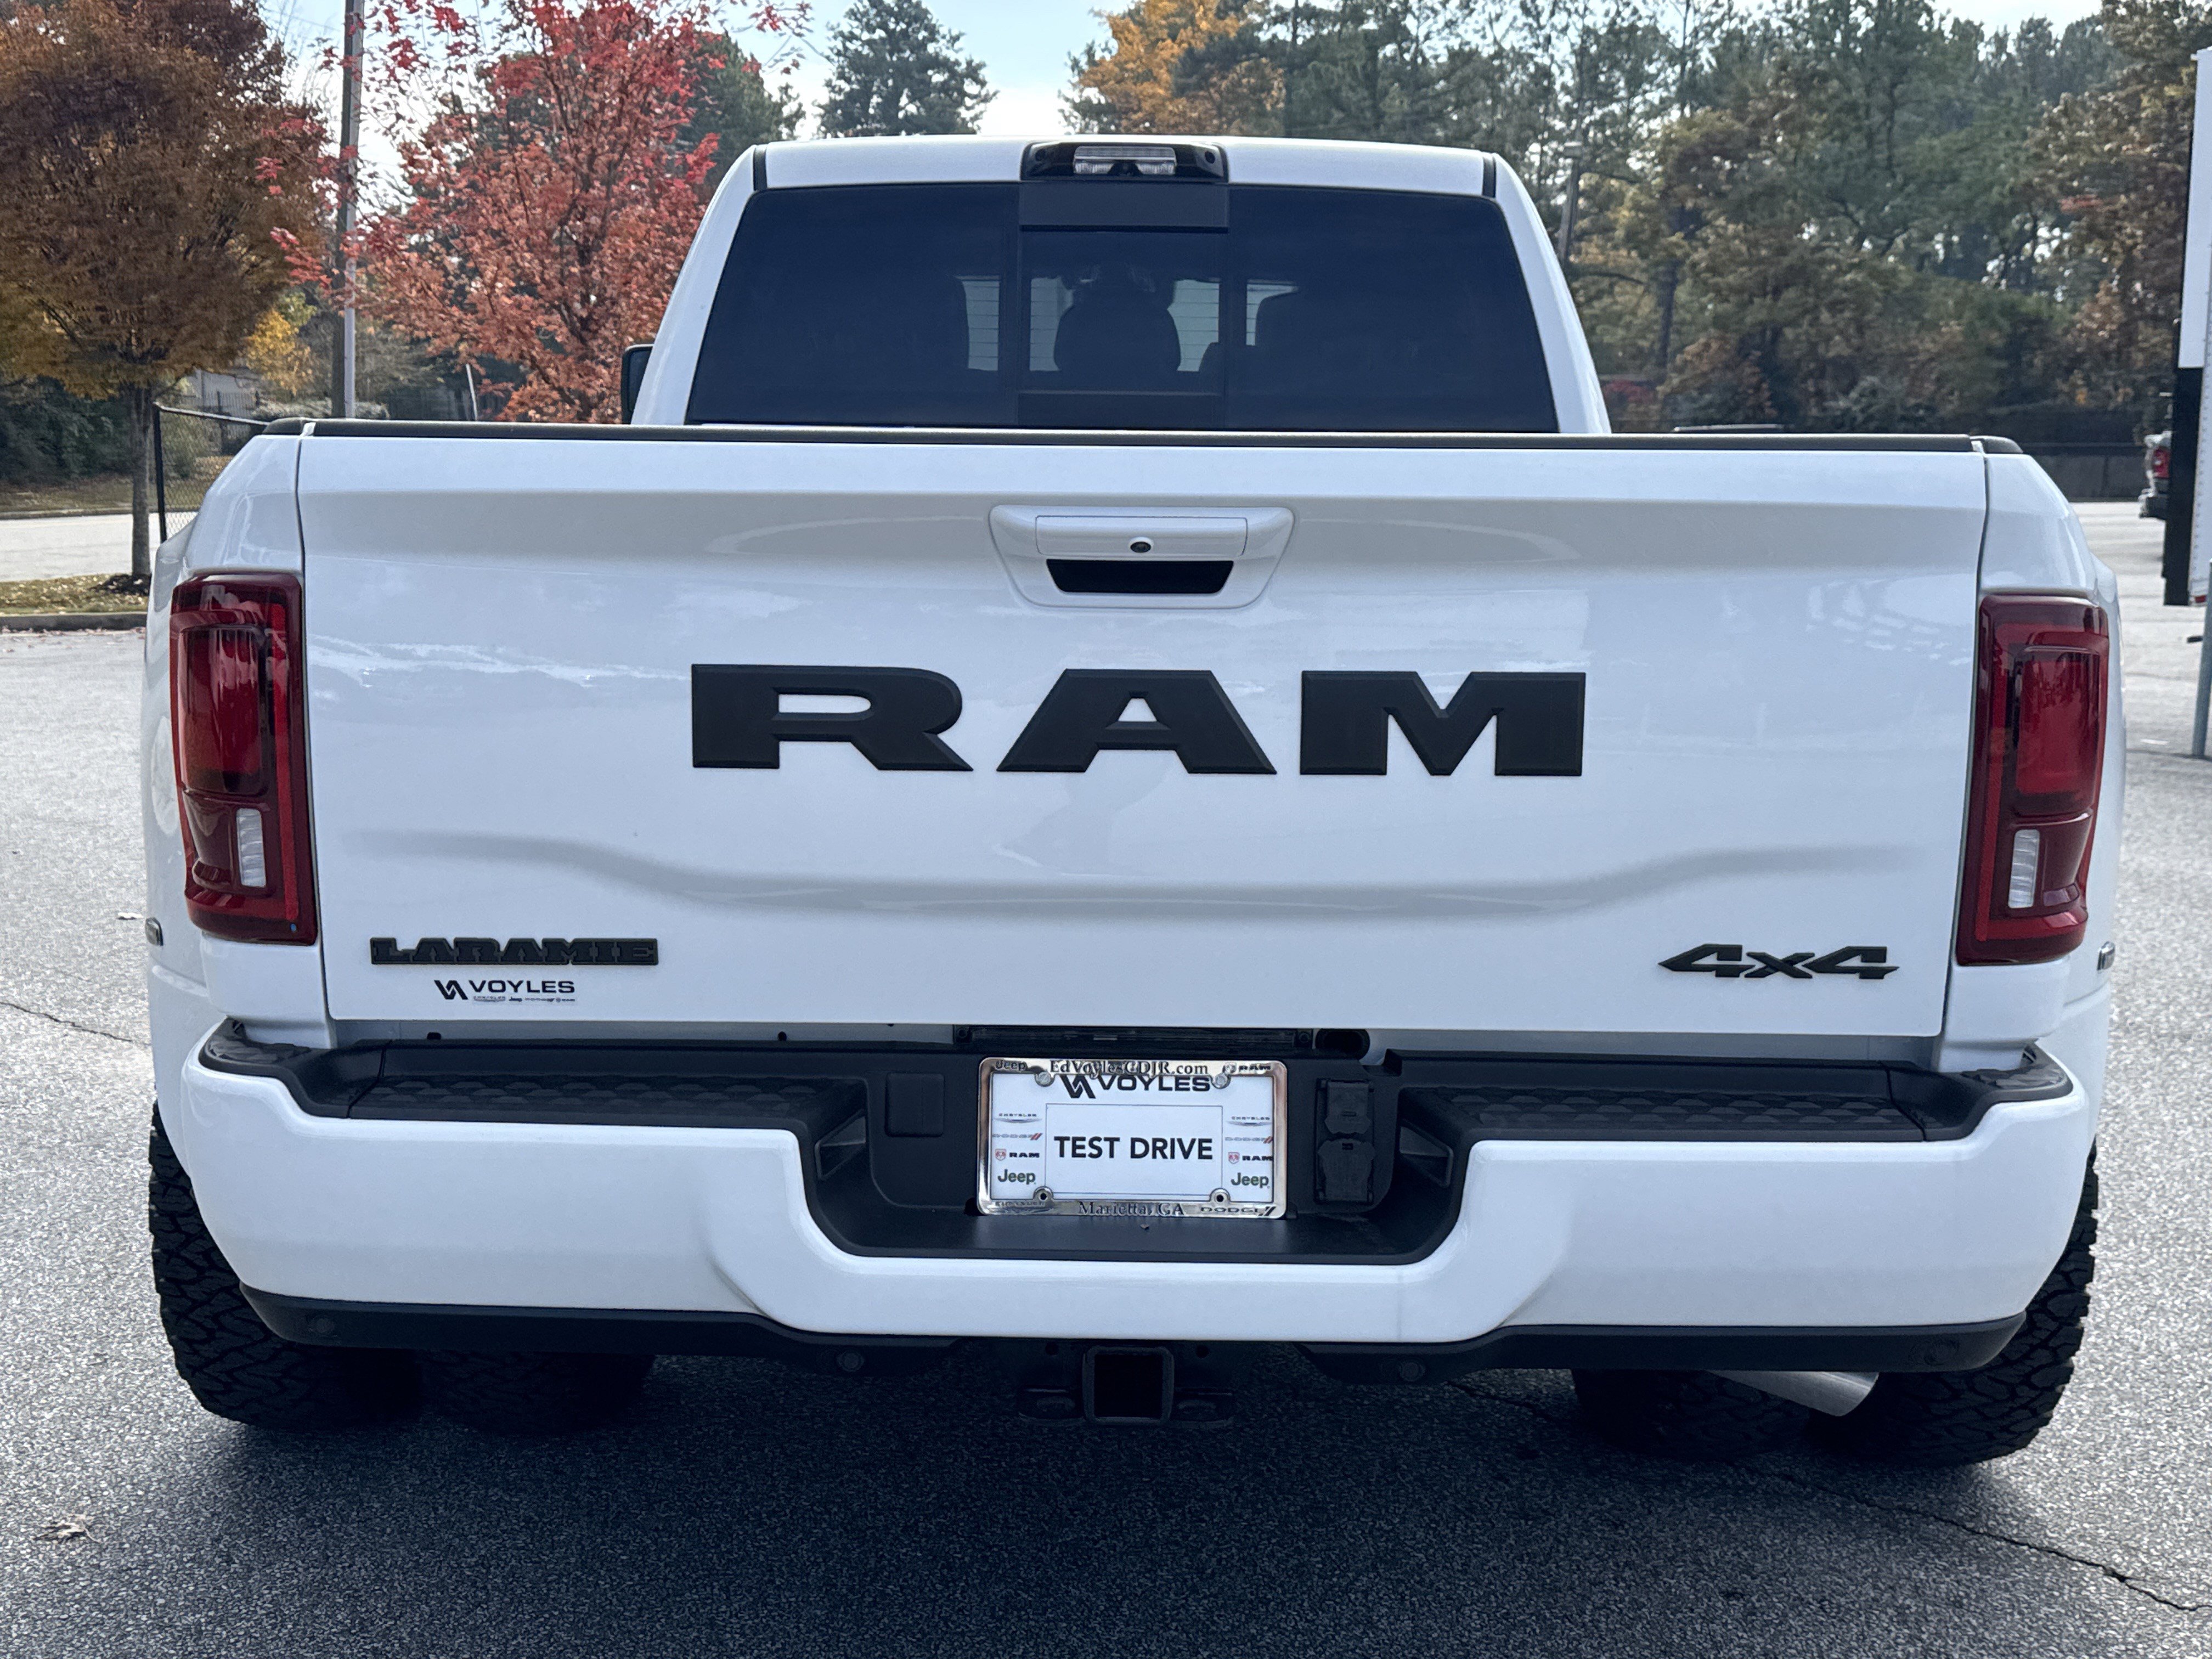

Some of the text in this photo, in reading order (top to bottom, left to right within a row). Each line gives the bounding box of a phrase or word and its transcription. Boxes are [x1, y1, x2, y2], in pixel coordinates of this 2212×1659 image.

[691, 663, 1586, 777] RAM
[370, 937, 659, 966] LARAMIE
[1657, 944, 1900, 979] 4x4
[469, 980, 575, 994] VOYLES
[995, 1060, 1028, 1071] Jeep
[1050, 1060, 1208, 1079] EdVoylesCDJR.com
[1097, 1075, 1210, 1091] VOYLES
[1054, 1136, 1213, 1160] TEST DRIVE
[997, 1169, 1036, 1185] Jeep
[1231, 1172, 1269, 1189] Jeep
[1159, 1203, 1185, 1216] GA
